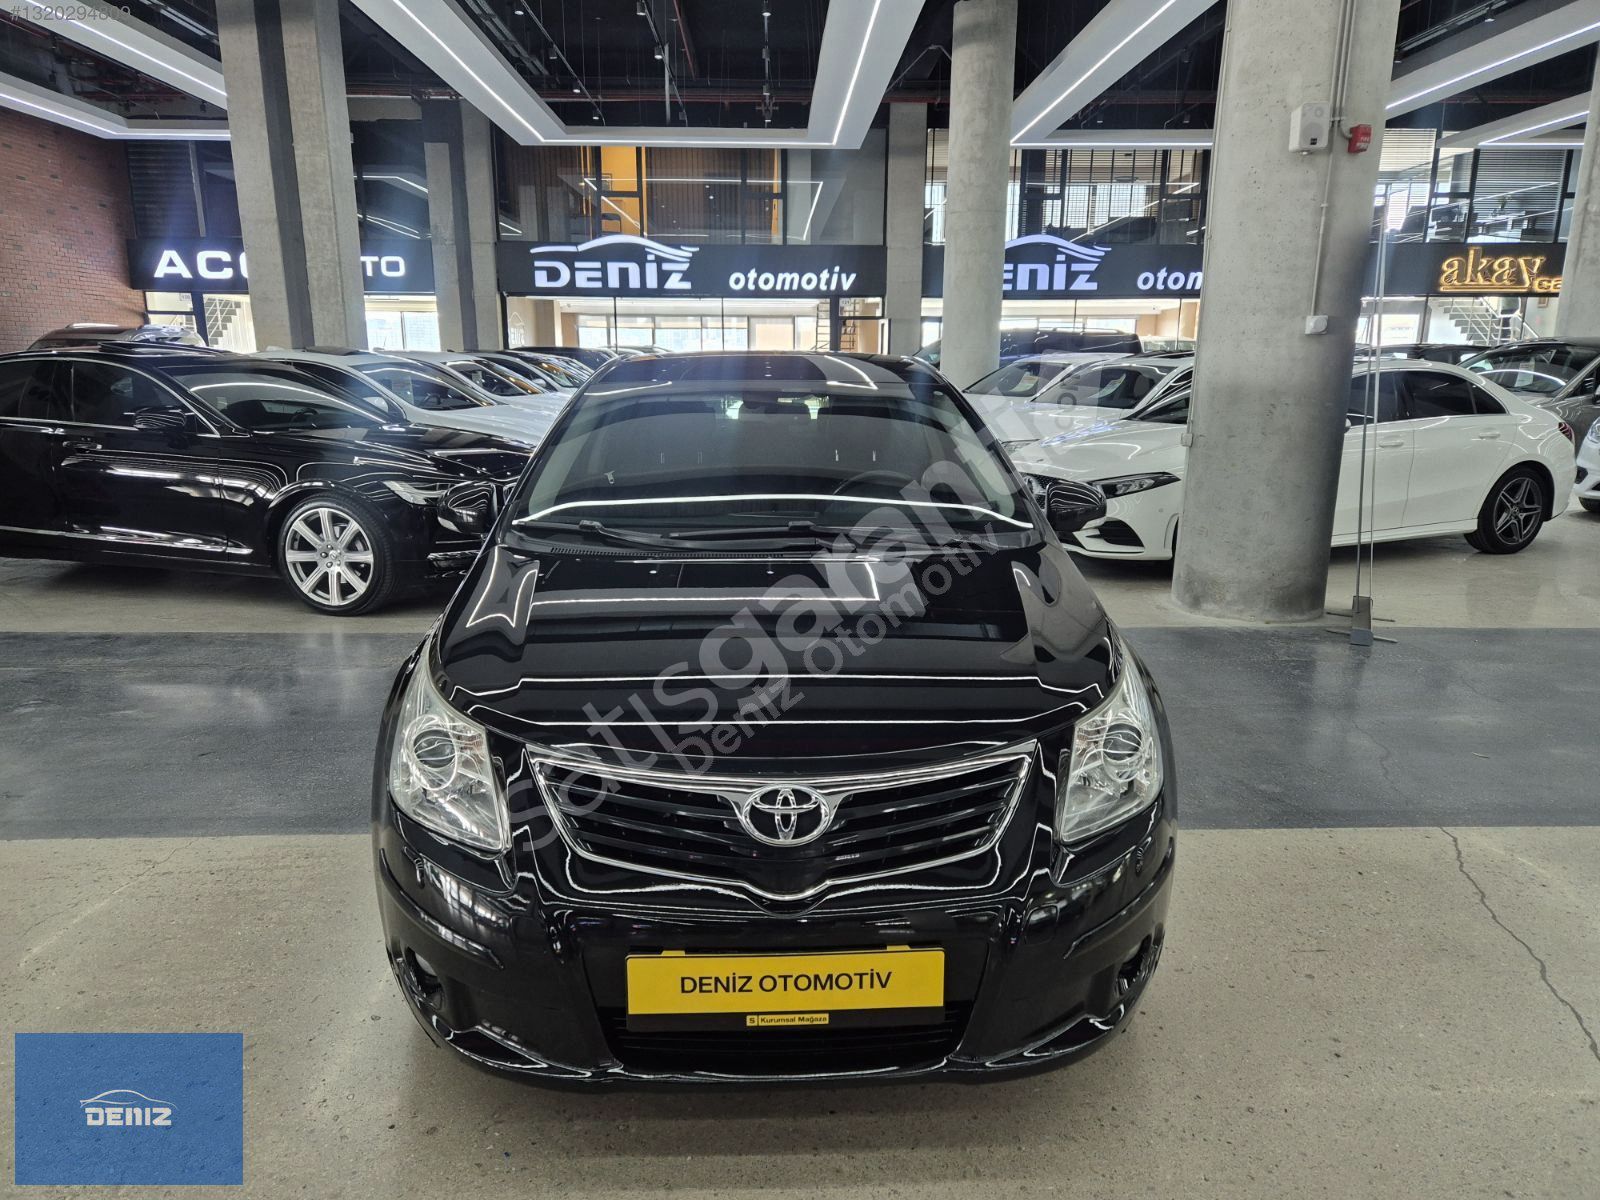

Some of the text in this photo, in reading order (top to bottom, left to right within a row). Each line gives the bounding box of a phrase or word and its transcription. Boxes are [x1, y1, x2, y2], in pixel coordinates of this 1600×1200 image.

[728, 266, 856, 290] otomotiv
[1440, 247, 1546, 288] akay
[681, 969, 892, 994] DENİZ OTOMOTİV
[760, 1016, 796, 1024] Kurumsal
